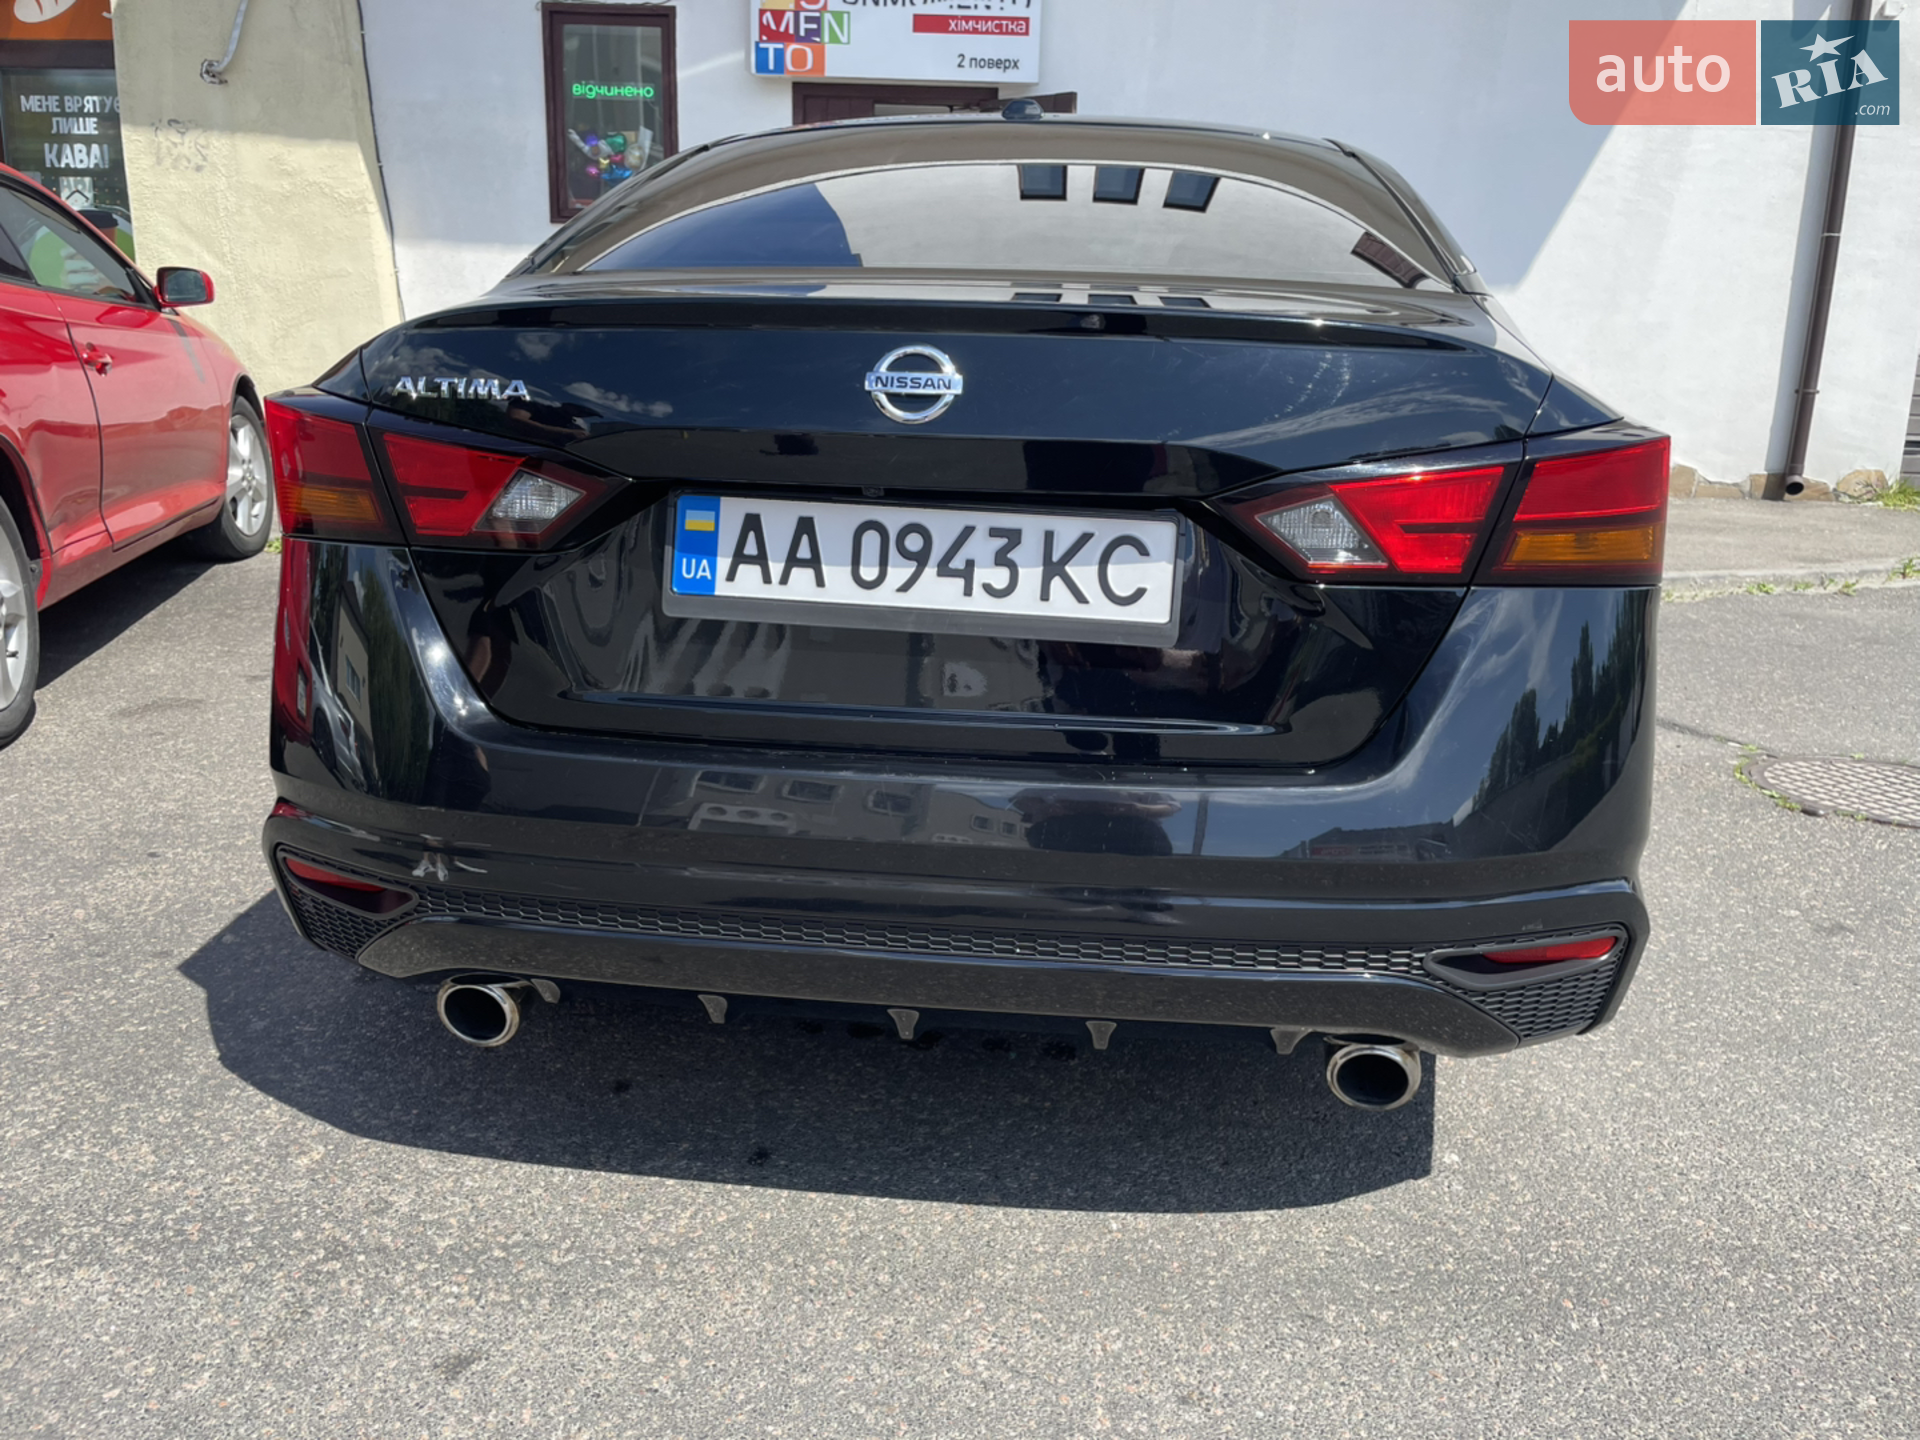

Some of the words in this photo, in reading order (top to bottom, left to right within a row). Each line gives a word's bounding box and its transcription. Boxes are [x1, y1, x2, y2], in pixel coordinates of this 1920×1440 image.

[948, 16, 1027, 34] хімчистка
[758, 43, 814, 73] TO
[956, 53, 966, 69] 2
[968, 57, 1021, 73] поверх
[572, 81, 655, 99] відчинено
[20, 95, 61, 113] МЕНЕ
[51, 117, 99, 134] ЛИШЕ
[44, 142, 110, 169] КАВА!
[392, 376, 531, 400] ALTIMA
[874, 375, 952, 390] NISSAN
[681, 557, 713, 581] UA
[725, 512, 826, 588] AA
[850, 519, 1023, 600] 0943
[1039, 529, 1152, 607] KC
